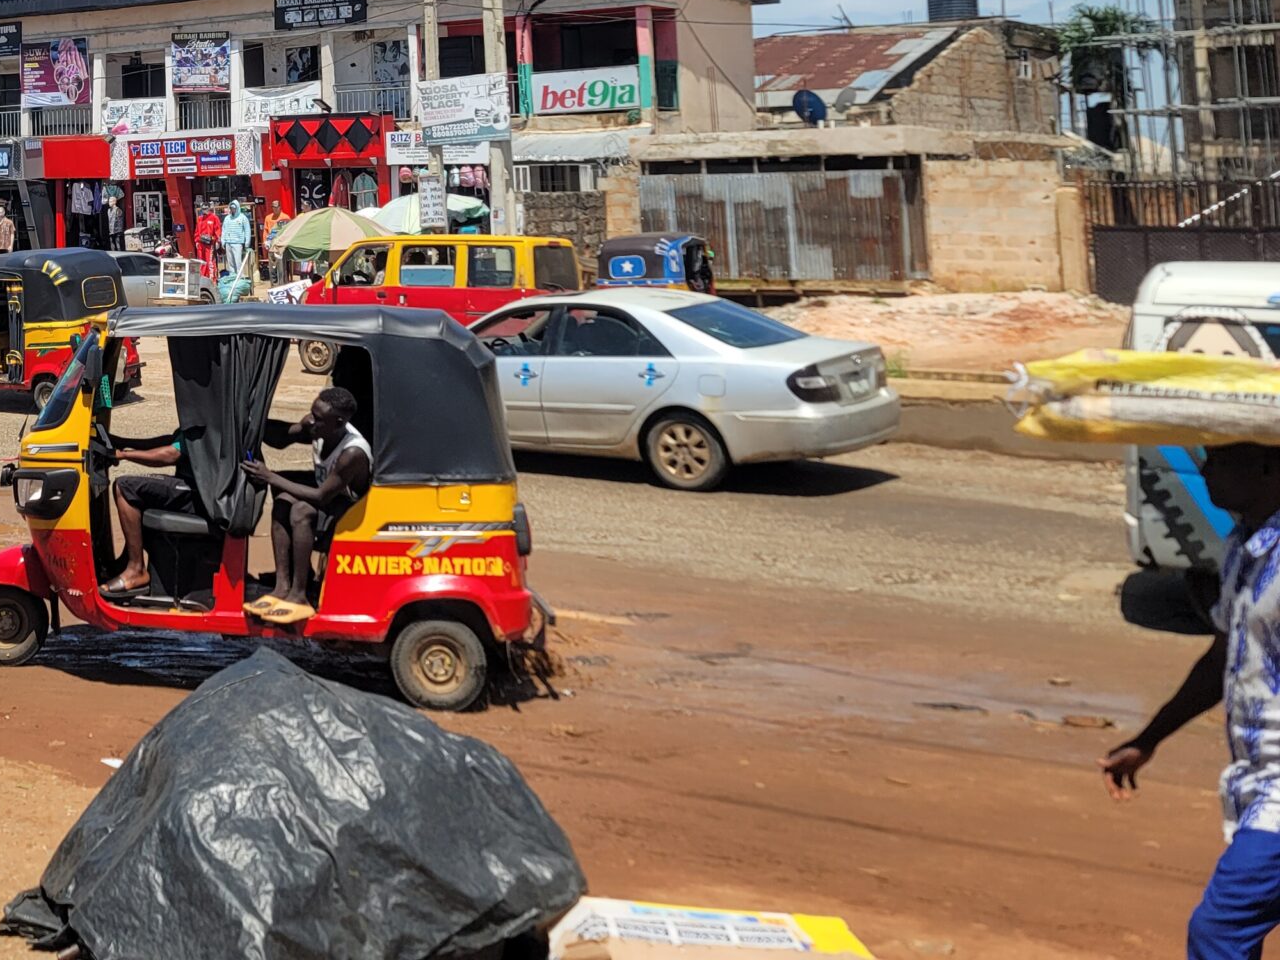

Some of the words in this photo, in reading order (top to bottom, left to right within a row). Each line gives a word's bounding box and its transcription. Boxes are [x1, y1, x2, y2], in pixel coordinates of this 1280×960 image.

[422, 91, 471, 101] PROPERTY
[541, 78, 635, 110] bet9ja
[141, 142, 160, 155] FEST
[165, 141, 186, 153] TECH
[190, 138, 232, 155] Gadgets
[336, 554, 413, 576] XAVIER
[422, 556, 506, 577] NATION
